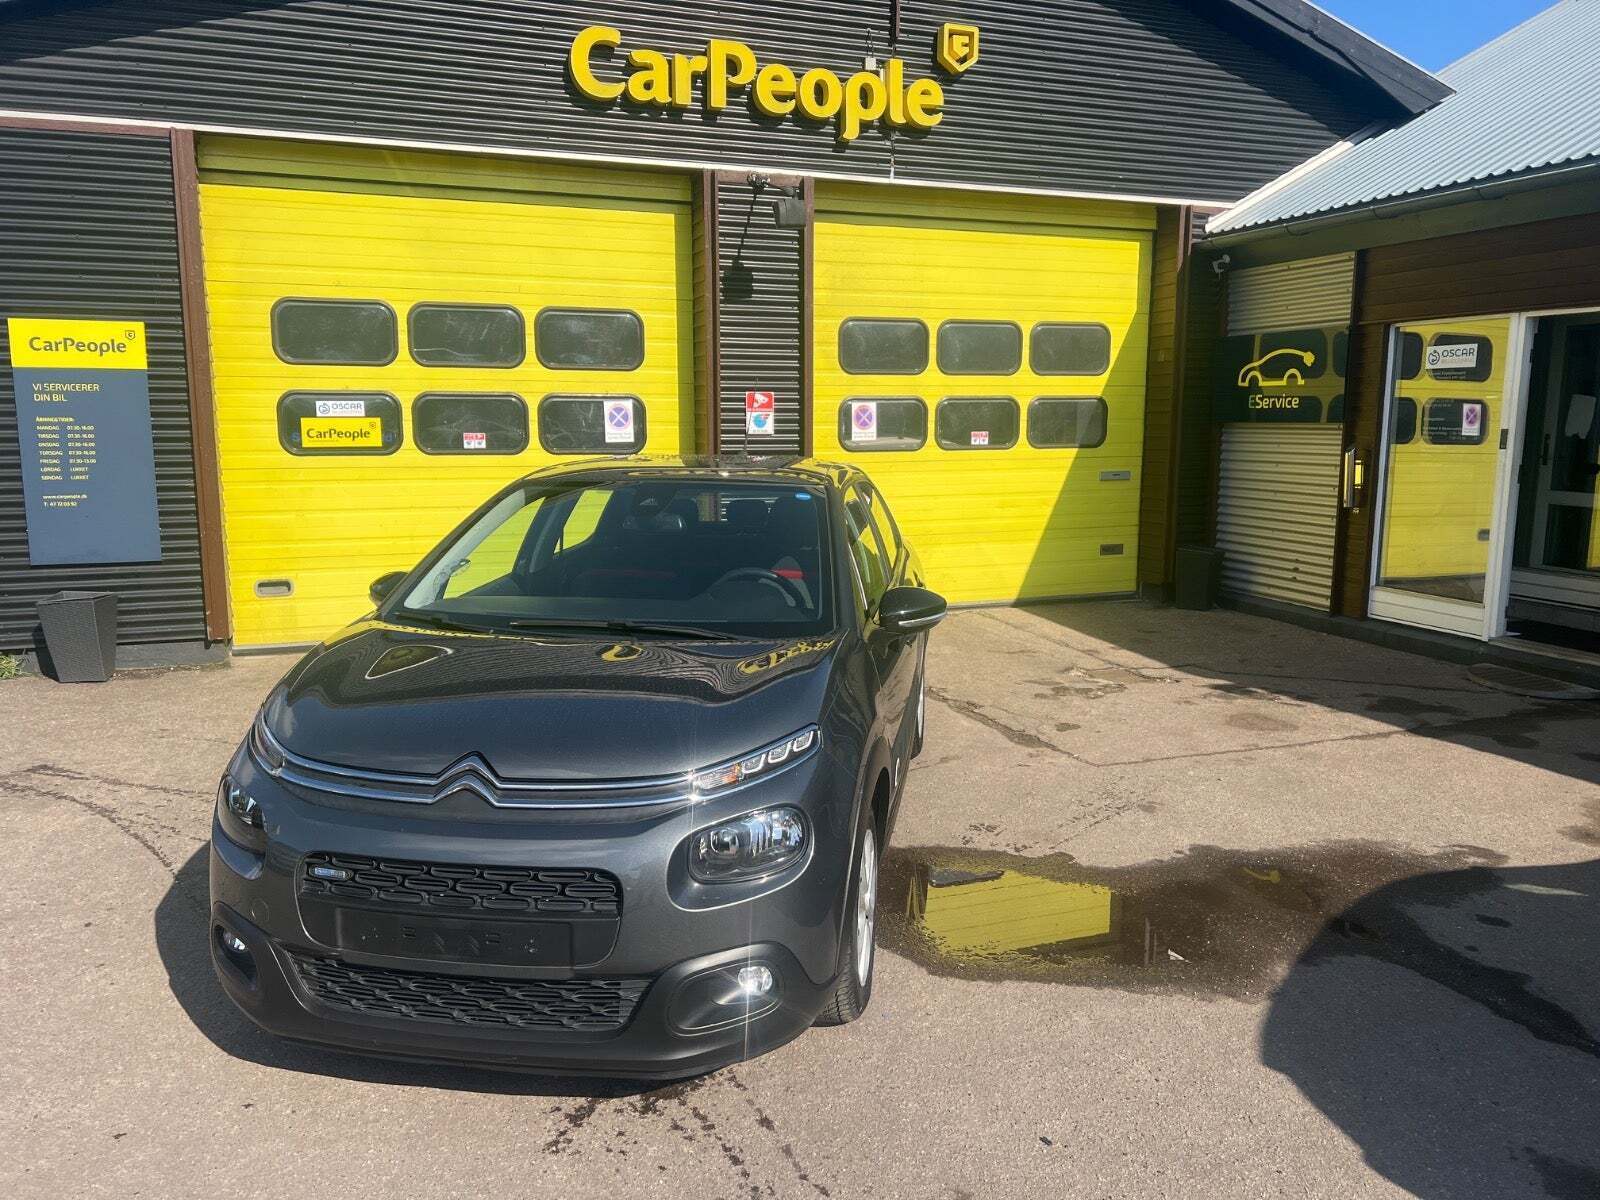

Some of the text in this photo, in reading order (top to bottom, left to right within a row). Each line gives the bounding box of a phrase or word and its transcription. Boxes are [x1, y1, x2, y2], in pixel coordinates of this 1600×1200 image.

[567, 24, 945, 141] CarPeople
[29, 336, 127, 357] CarPeople
[1441, 347, 1475, 358] OSCAR
[32, 383, 100, 392] VI SERVICERER
[33, 393, 68, 402] DIN BIL
[1248, 393, 1300, 410] EService
[306, 427, 371, 441] CarPeople
